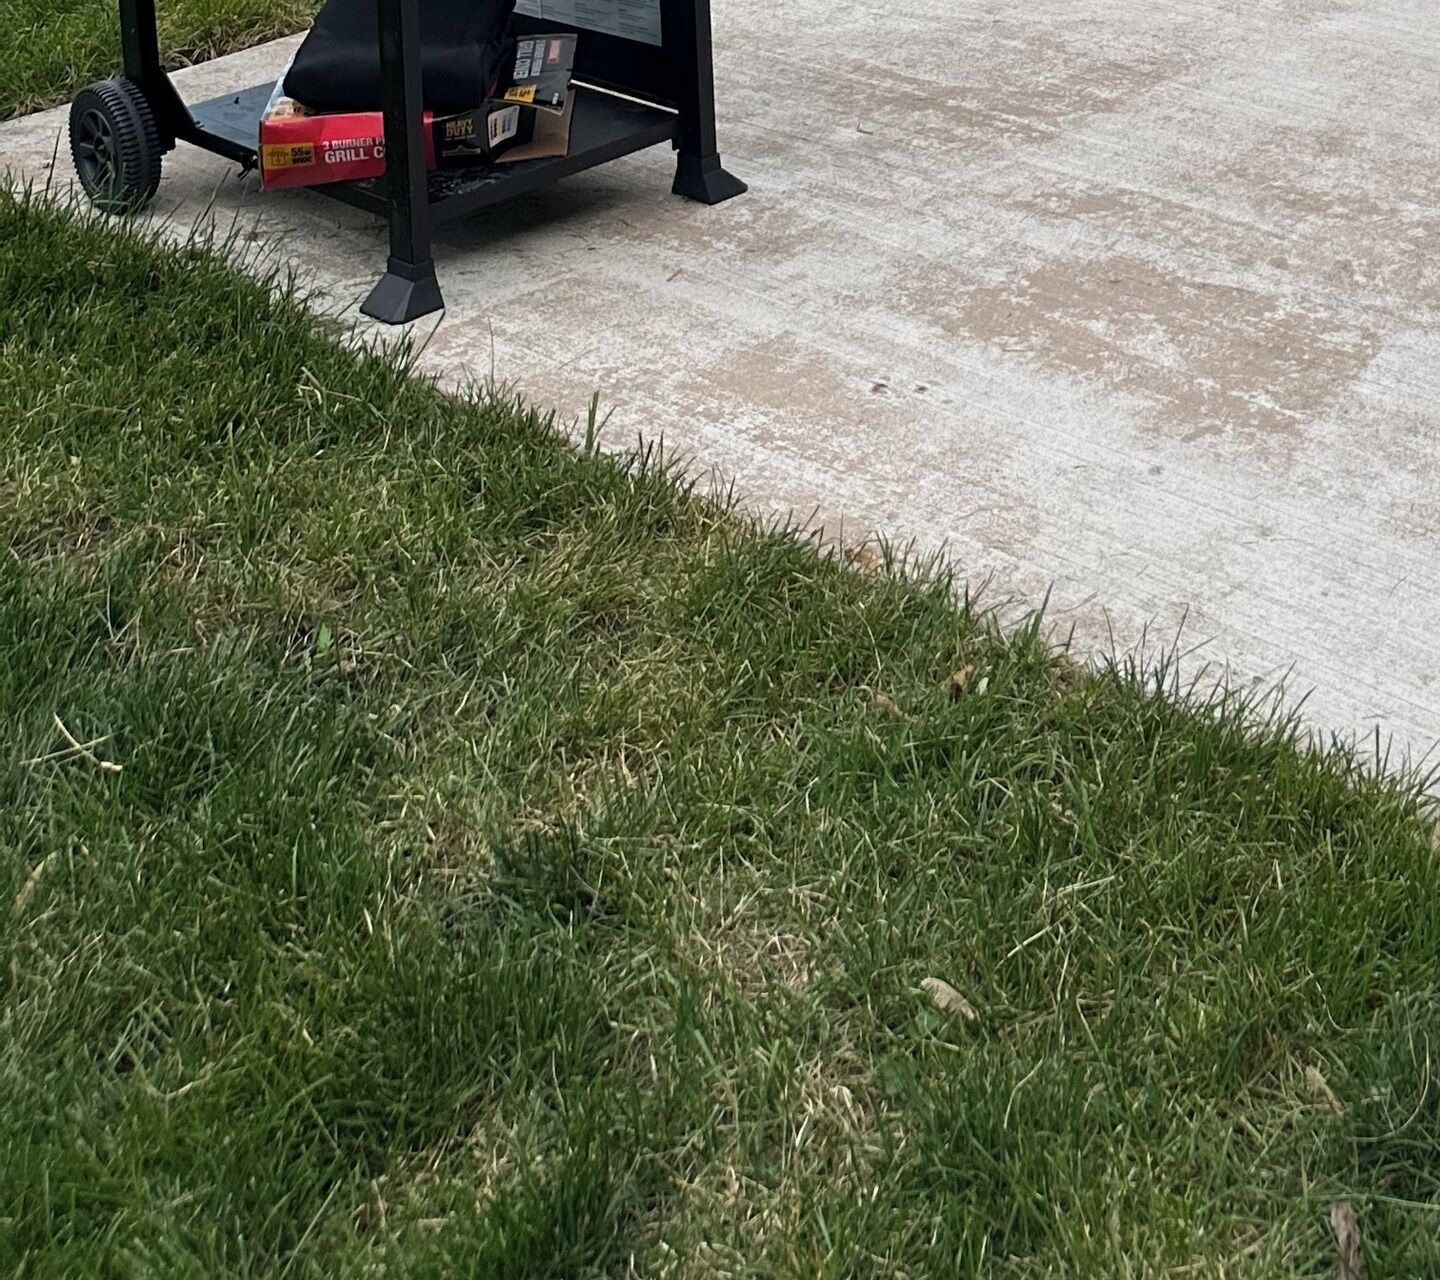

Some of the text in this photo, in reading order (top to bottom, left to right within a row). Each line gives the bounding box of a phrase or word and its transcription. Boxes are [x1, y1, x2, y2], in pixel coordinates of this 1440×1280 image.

[446, 126, 473, 137] DUTY
[322, 141, 329, 150] 3
[332, 138, 373, 149] BURNER
[325, 146, 385, 163] GRILL C
